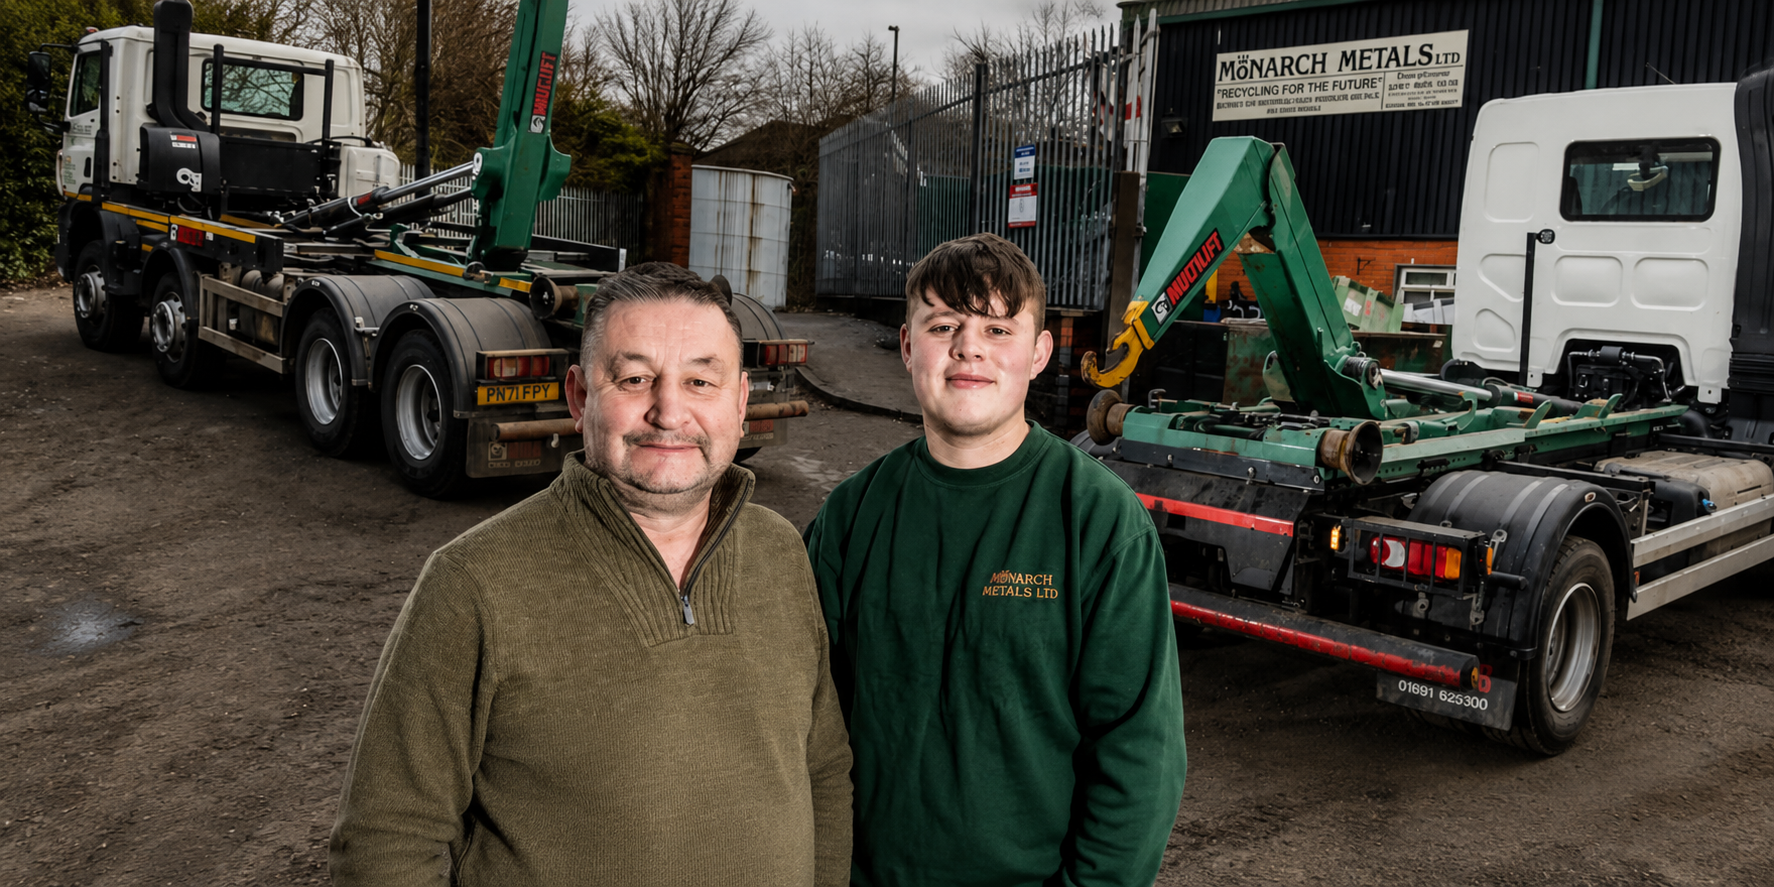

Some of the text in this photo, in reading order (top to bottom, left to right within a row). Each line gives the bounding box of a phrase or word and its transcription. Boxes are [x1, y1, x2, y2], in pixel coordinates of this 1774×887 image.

[1337, 43, 1434, 72] METALS
[1435, 52, 1460, 65] LTD
[1282, 83, 1305, 95] FOR
[1308, 81, 1329, 93] THE
[522, 384, 550, 400] FPY
[989, 570, 1053, 586] MONARCH
[982, 585, 1058, 599] METALS LTD
[1398, 680, 1488, 711] 01691 625300
